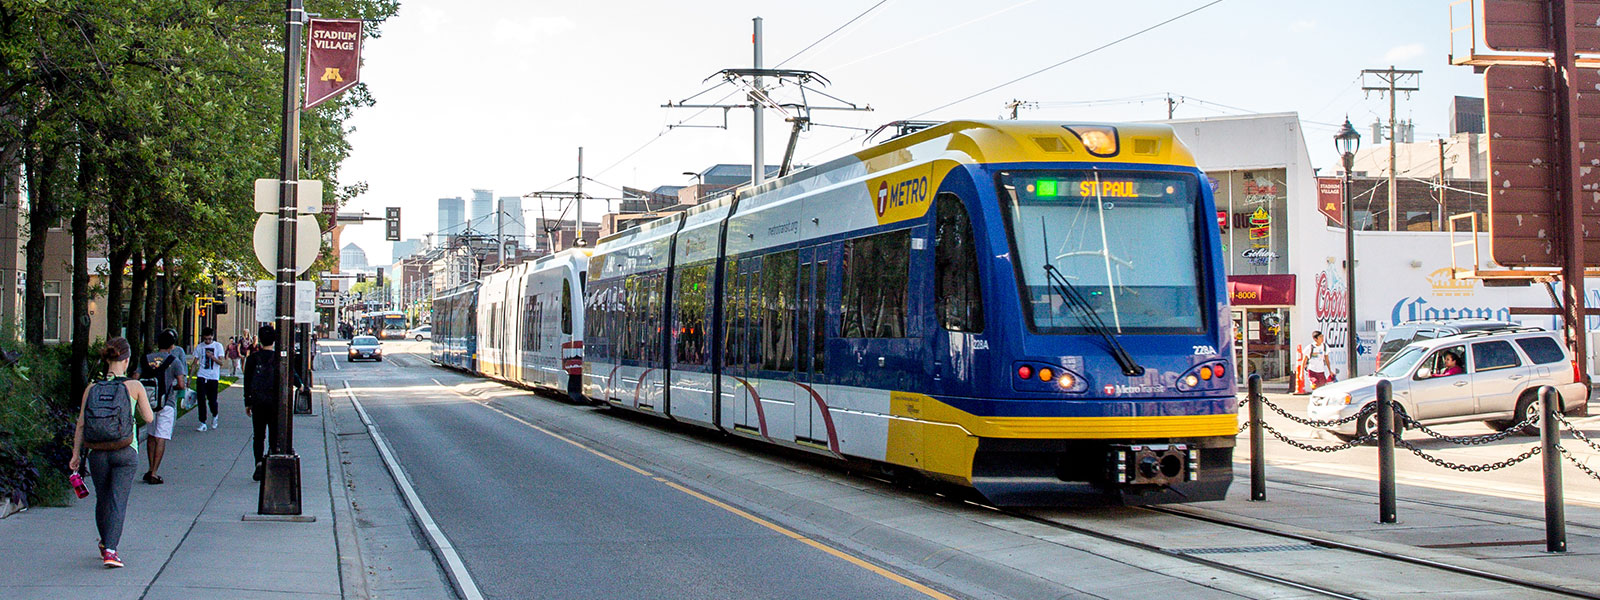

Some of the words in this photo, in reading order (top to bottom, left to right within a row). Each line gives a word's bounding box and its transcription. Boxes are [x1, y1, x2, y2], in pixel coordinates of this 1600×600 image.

[313, 30, 357, 40] STADIUM
[315, 40, 354, 50] VILLAGE
[889, 175, 928, 209] METRO
[1080, 181, 1097, 197] ST
[1102, 181, 1139, 197] PAUL
[1315, 271, 1348, 322] Coors
[1391, 296, 1511, 327] Corona
[1192, 345, 1217, 355] 228A
